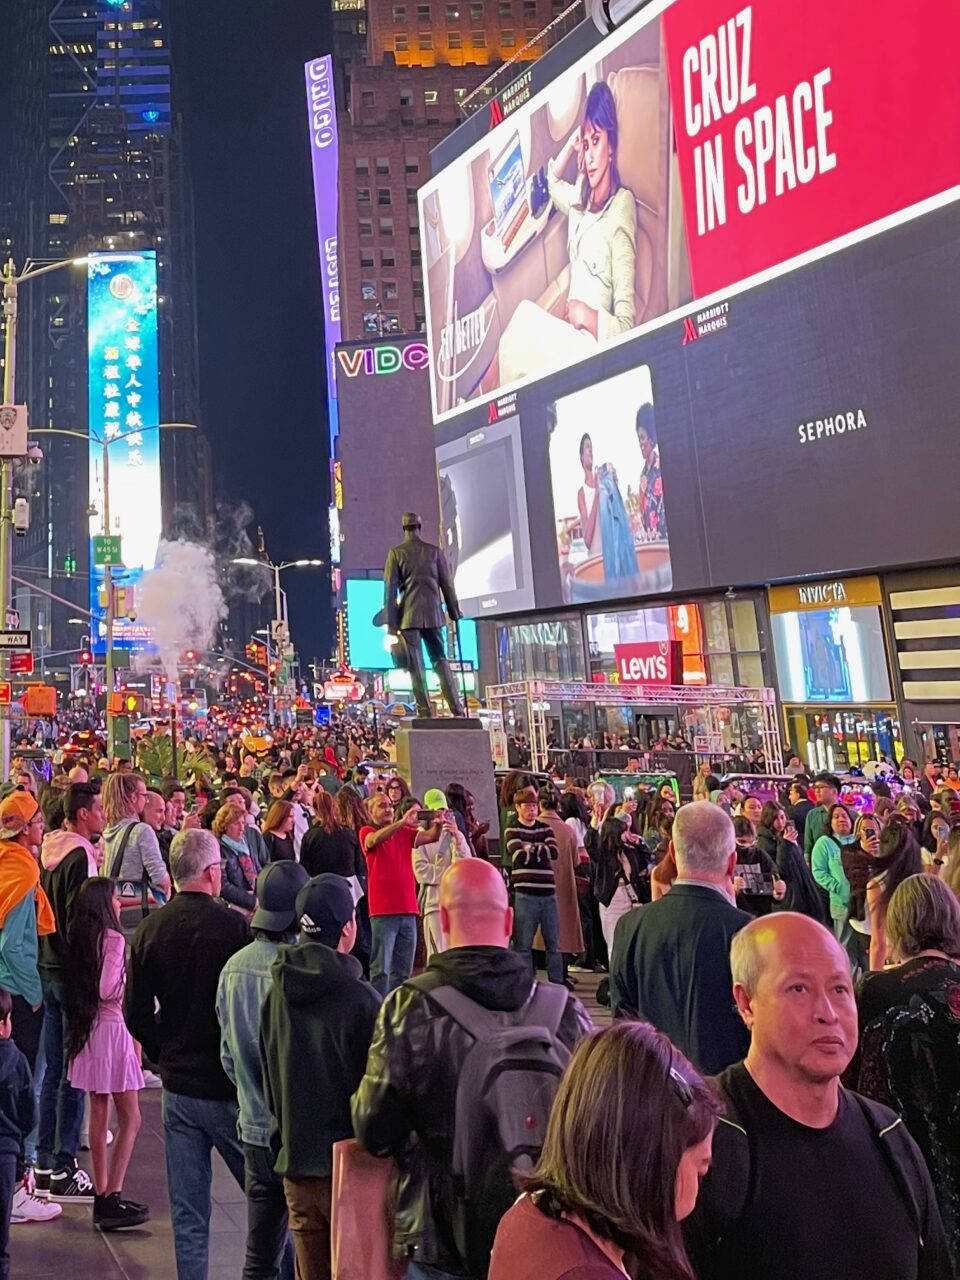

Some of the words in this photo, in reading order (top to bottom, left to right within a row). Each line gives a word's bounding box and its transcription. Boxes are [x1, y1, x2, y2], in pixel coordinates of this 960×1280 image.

[683, 5, 756, 136] CRUZ
[503, 71, 531, 102] MARRIOTT
[503, 88, 530, 116] MARQUIS
[694, 134, 726, 236] IN
[735, 67, 836, 213] SPACE
[697, 302, 729, 323] MARRIOTT
[698, 316, 728, 336] MARQUIS
[454, 306, 486, 355] BETTER
[799, 409, 867, 443] SEPHORA
[799, 582, 847, 604] INVICTA
[7, 635, 24, 644] WAY
